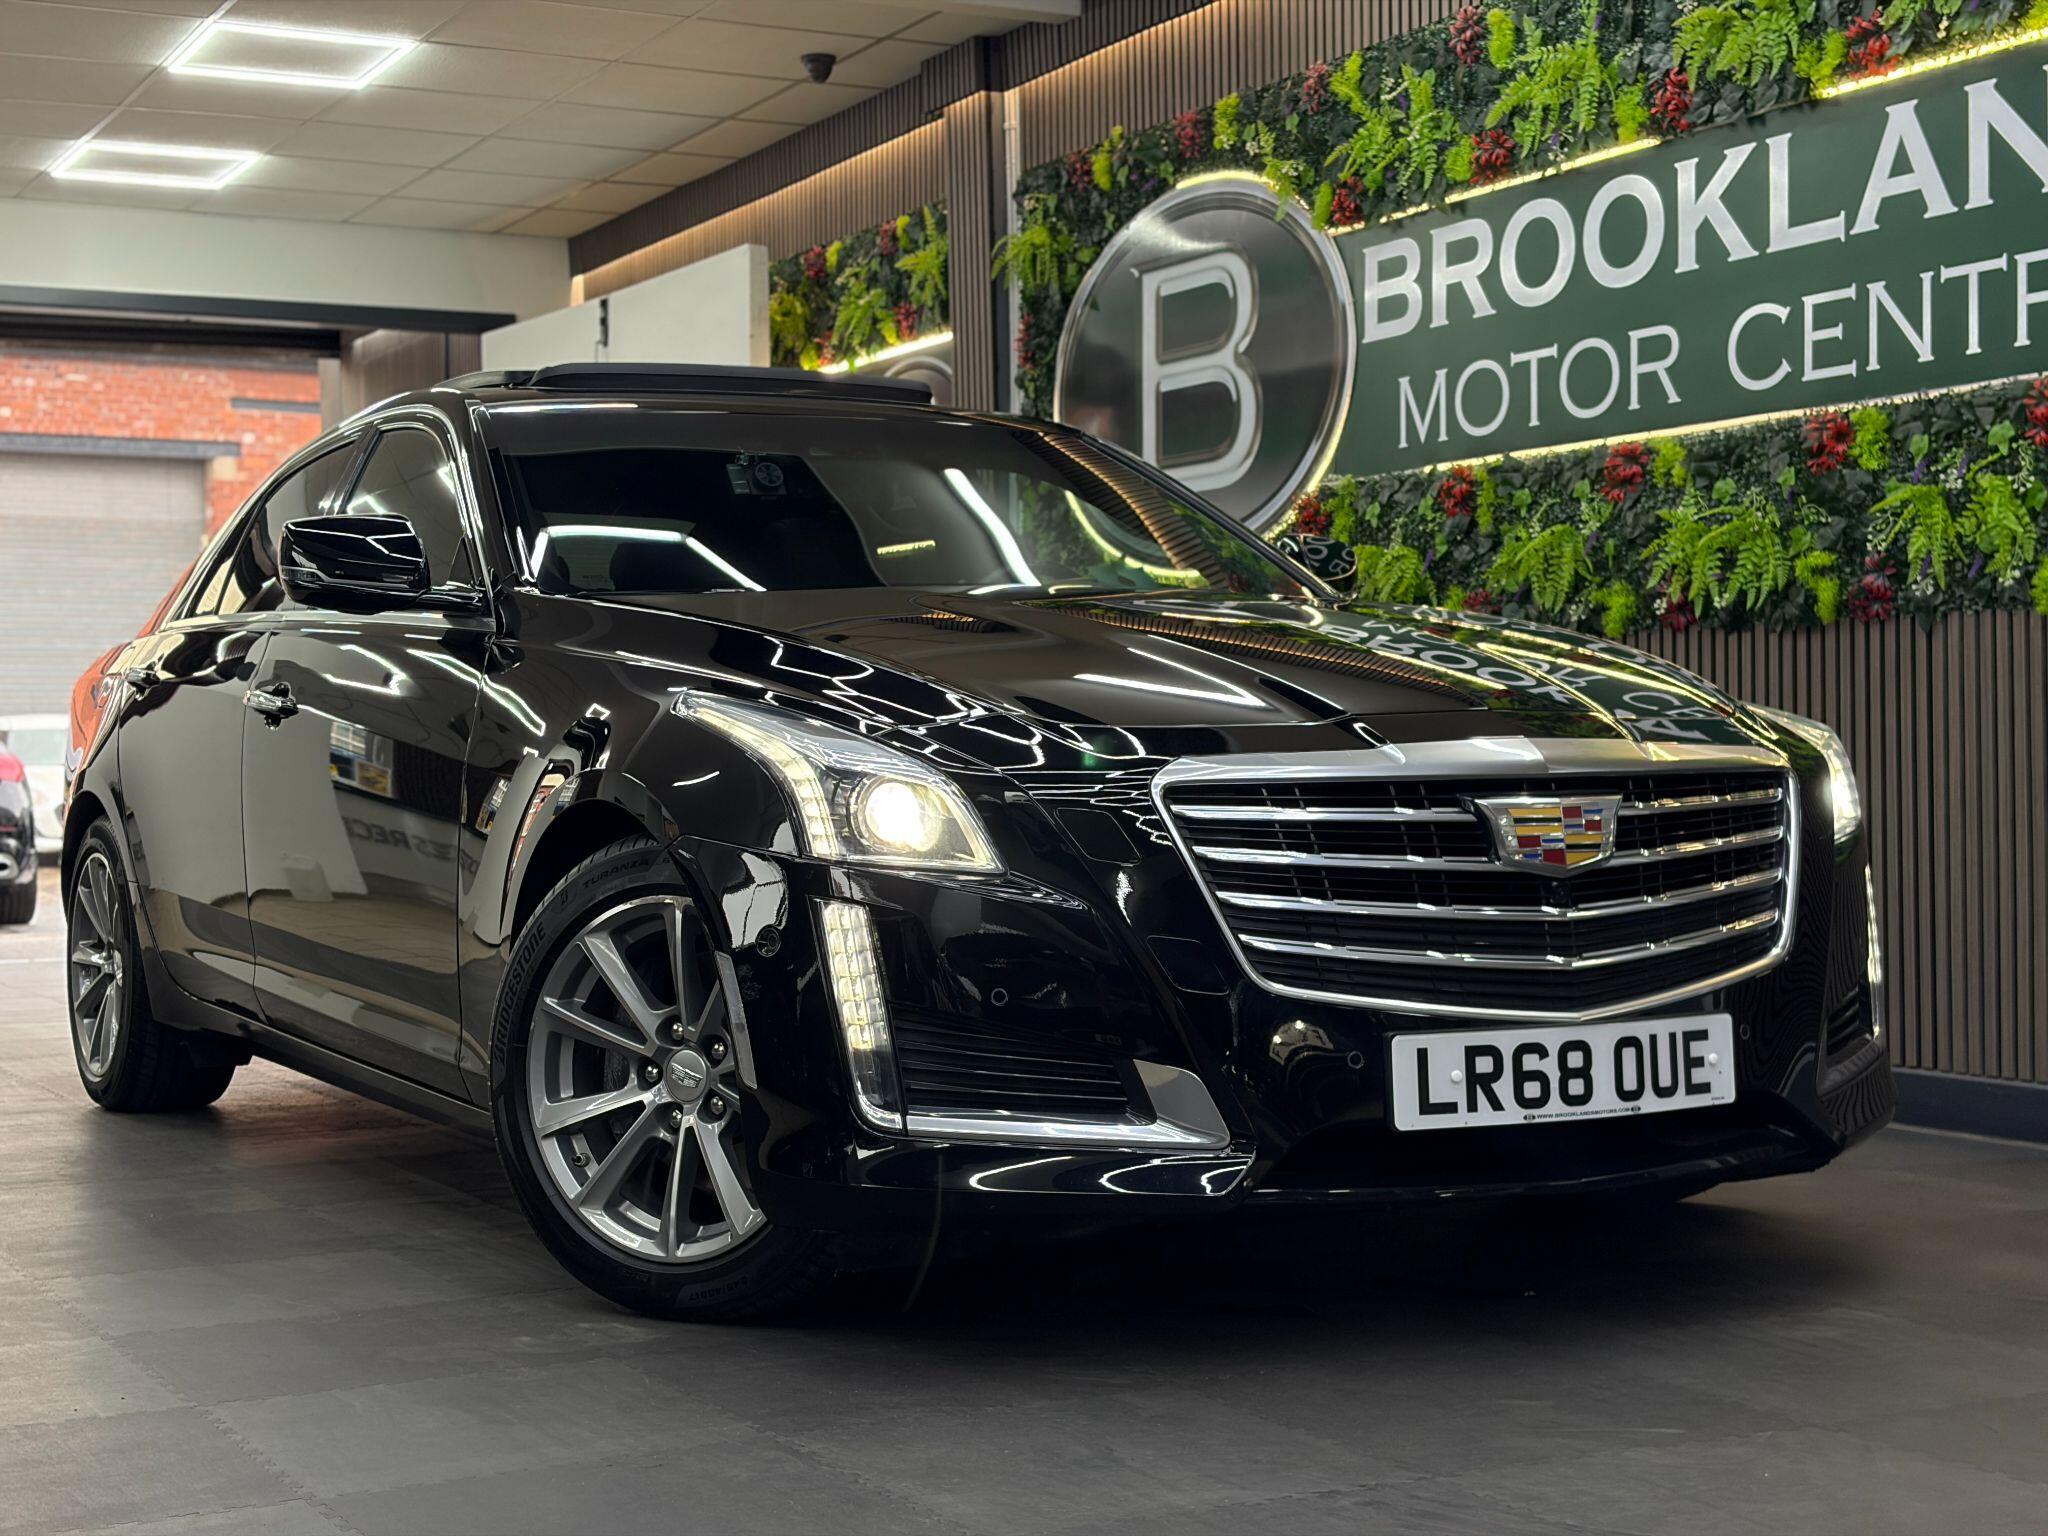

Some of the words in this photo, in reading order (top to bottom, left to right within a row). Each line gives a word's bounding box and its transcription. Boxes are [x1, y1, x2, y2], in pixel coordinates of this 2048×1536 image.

[1362, 62, 2048, 344] BROOKLAN
[1131, 246, 1262, 493] B
[1398, 324, 1682, 450] MOTOR
[494, 921, 547, 1067] BRIDGESTONE
[1416, 1039, 1595, 1116] LR68
[1613, 1029, 1712, 1104] OUE
